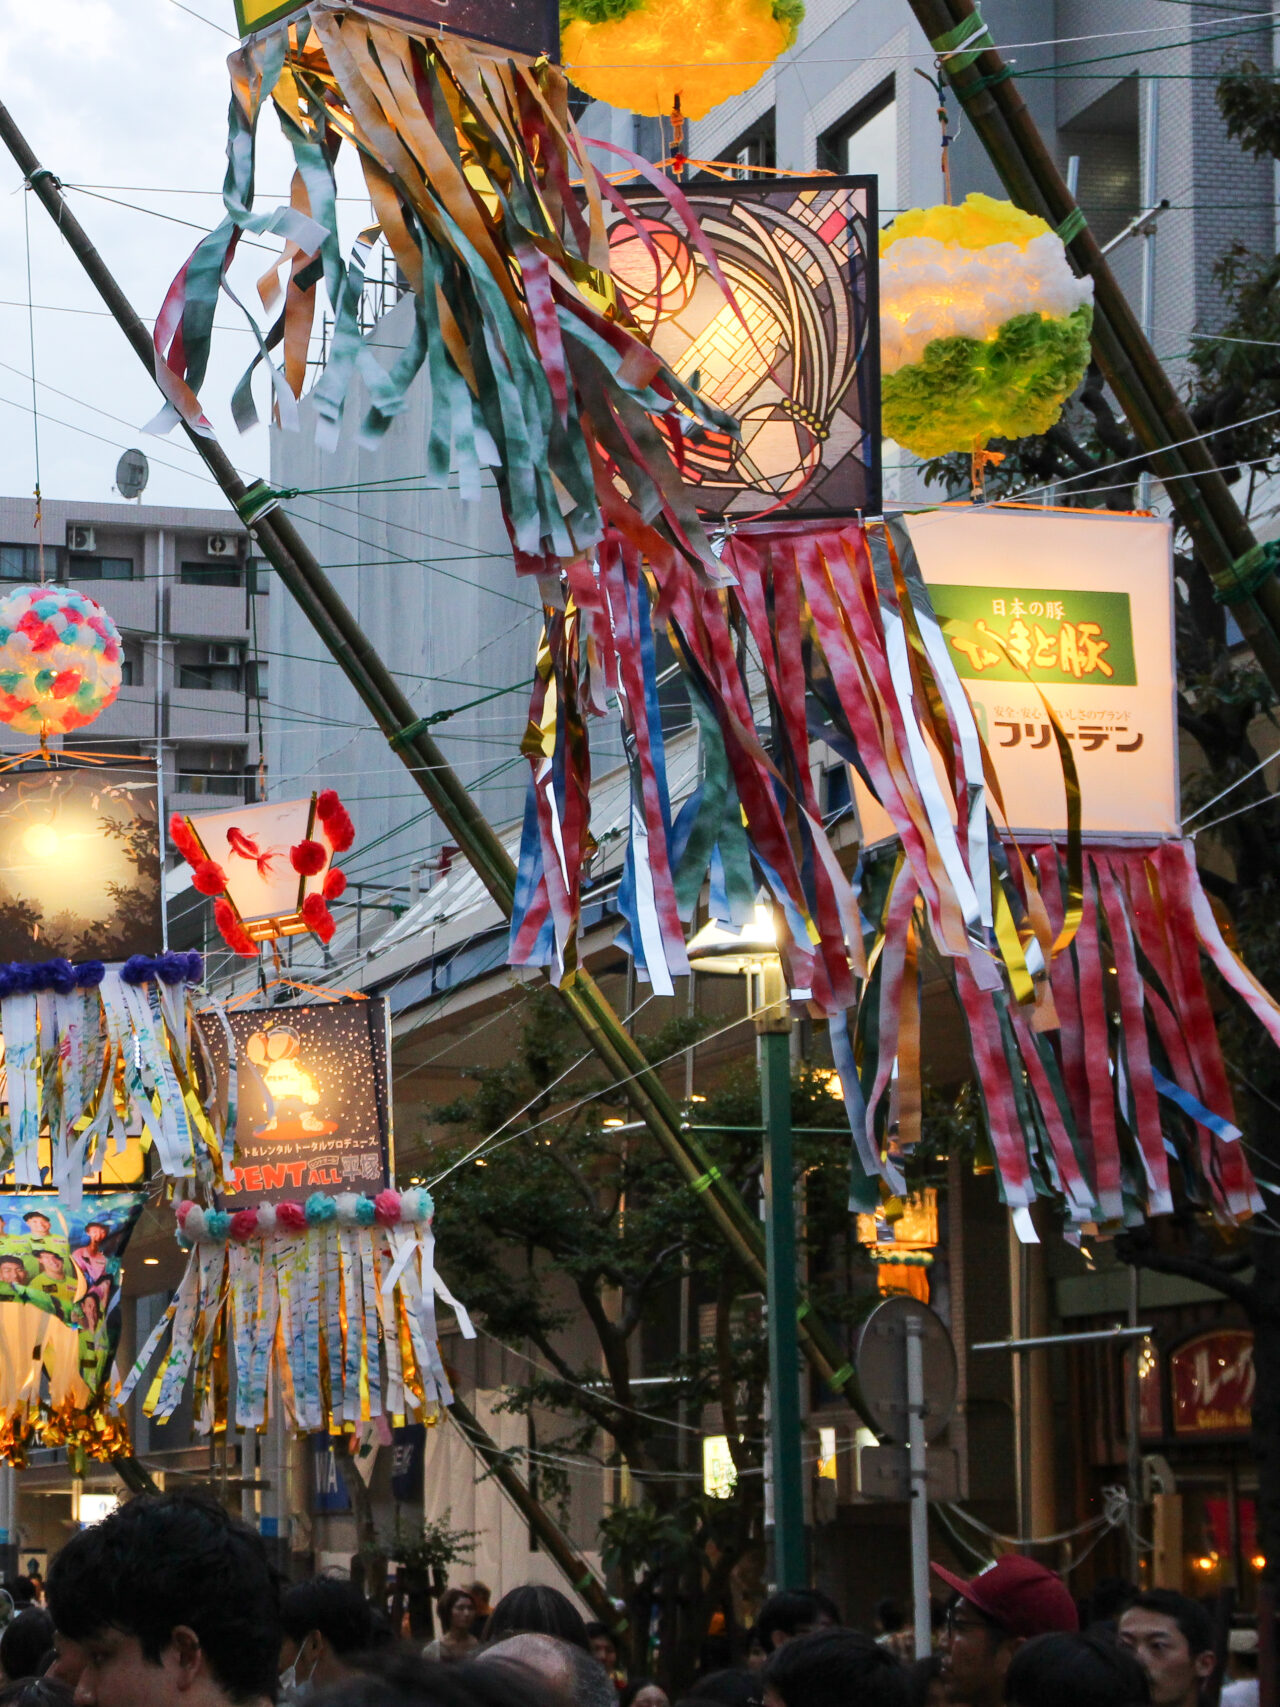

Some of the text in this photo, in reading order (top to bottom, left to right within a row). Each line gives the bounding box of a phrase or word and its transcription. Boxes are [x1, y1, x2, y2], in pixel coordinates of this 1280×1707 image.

[992, 599, 1066, 620] 日本の豚
[228, 1161, 307, 1194] RENT
[308, 1168, 342, 1185] ALL
[341, 1153, 381, 1182] 平塚
